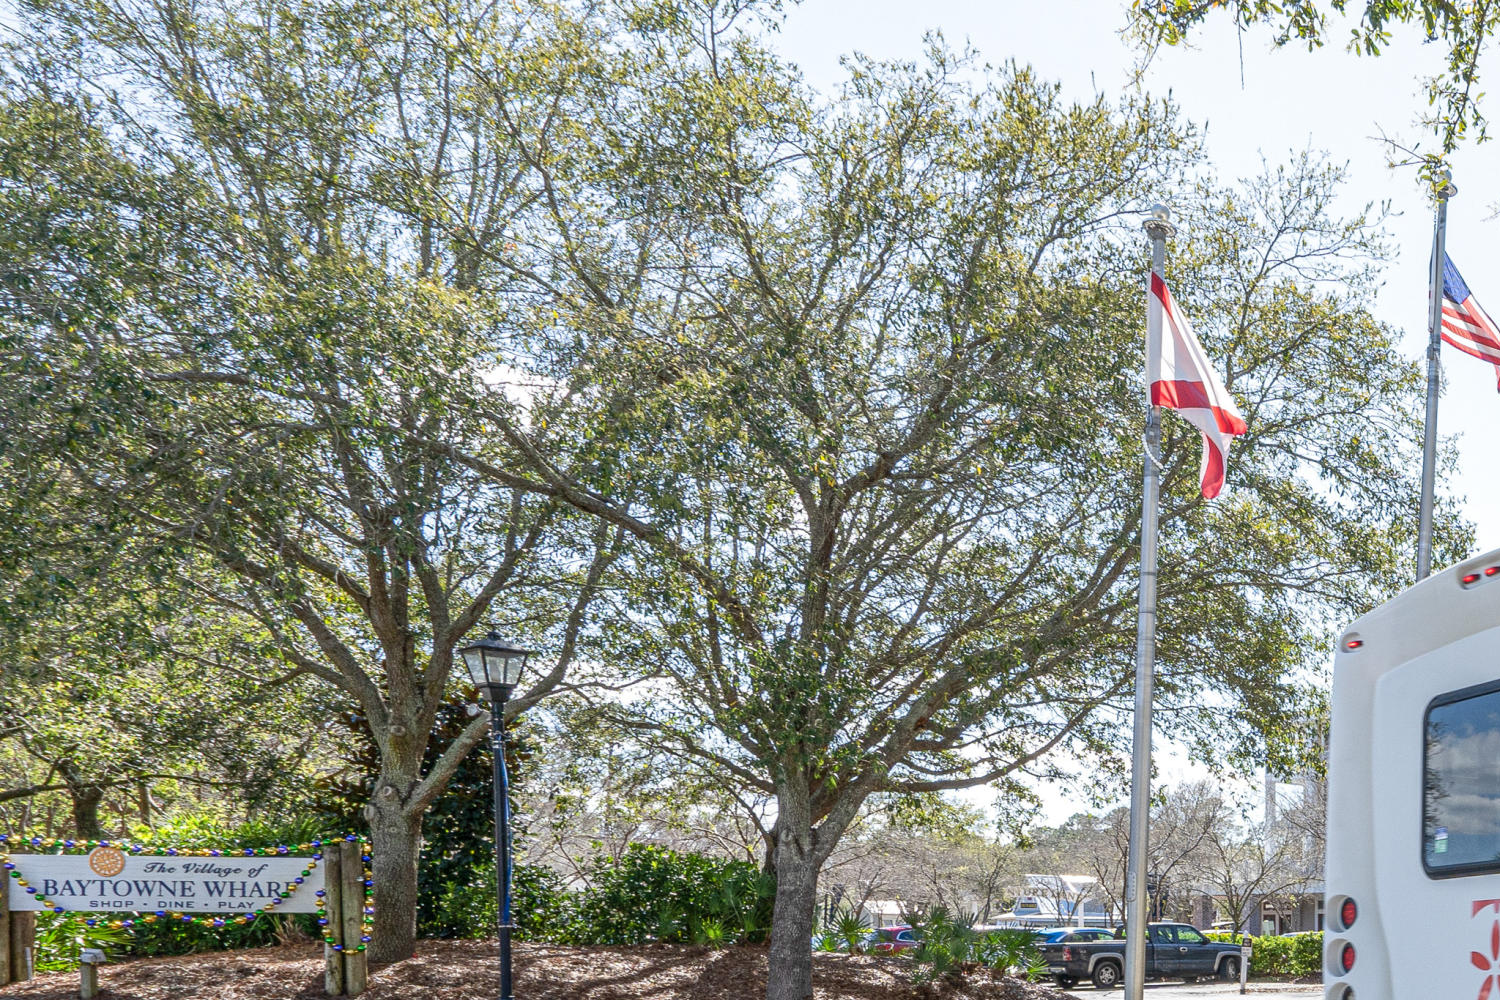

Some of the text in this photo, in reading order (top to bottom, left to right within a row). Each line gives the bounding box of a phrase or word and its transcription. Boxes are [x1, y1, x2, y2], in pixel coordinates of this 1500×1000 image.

[143, 862, 269, 878] The Village of
[43, 879, 196, 898] BAYTOWNE
[89, 900, 255, 910] SHOP DINE PLAY
